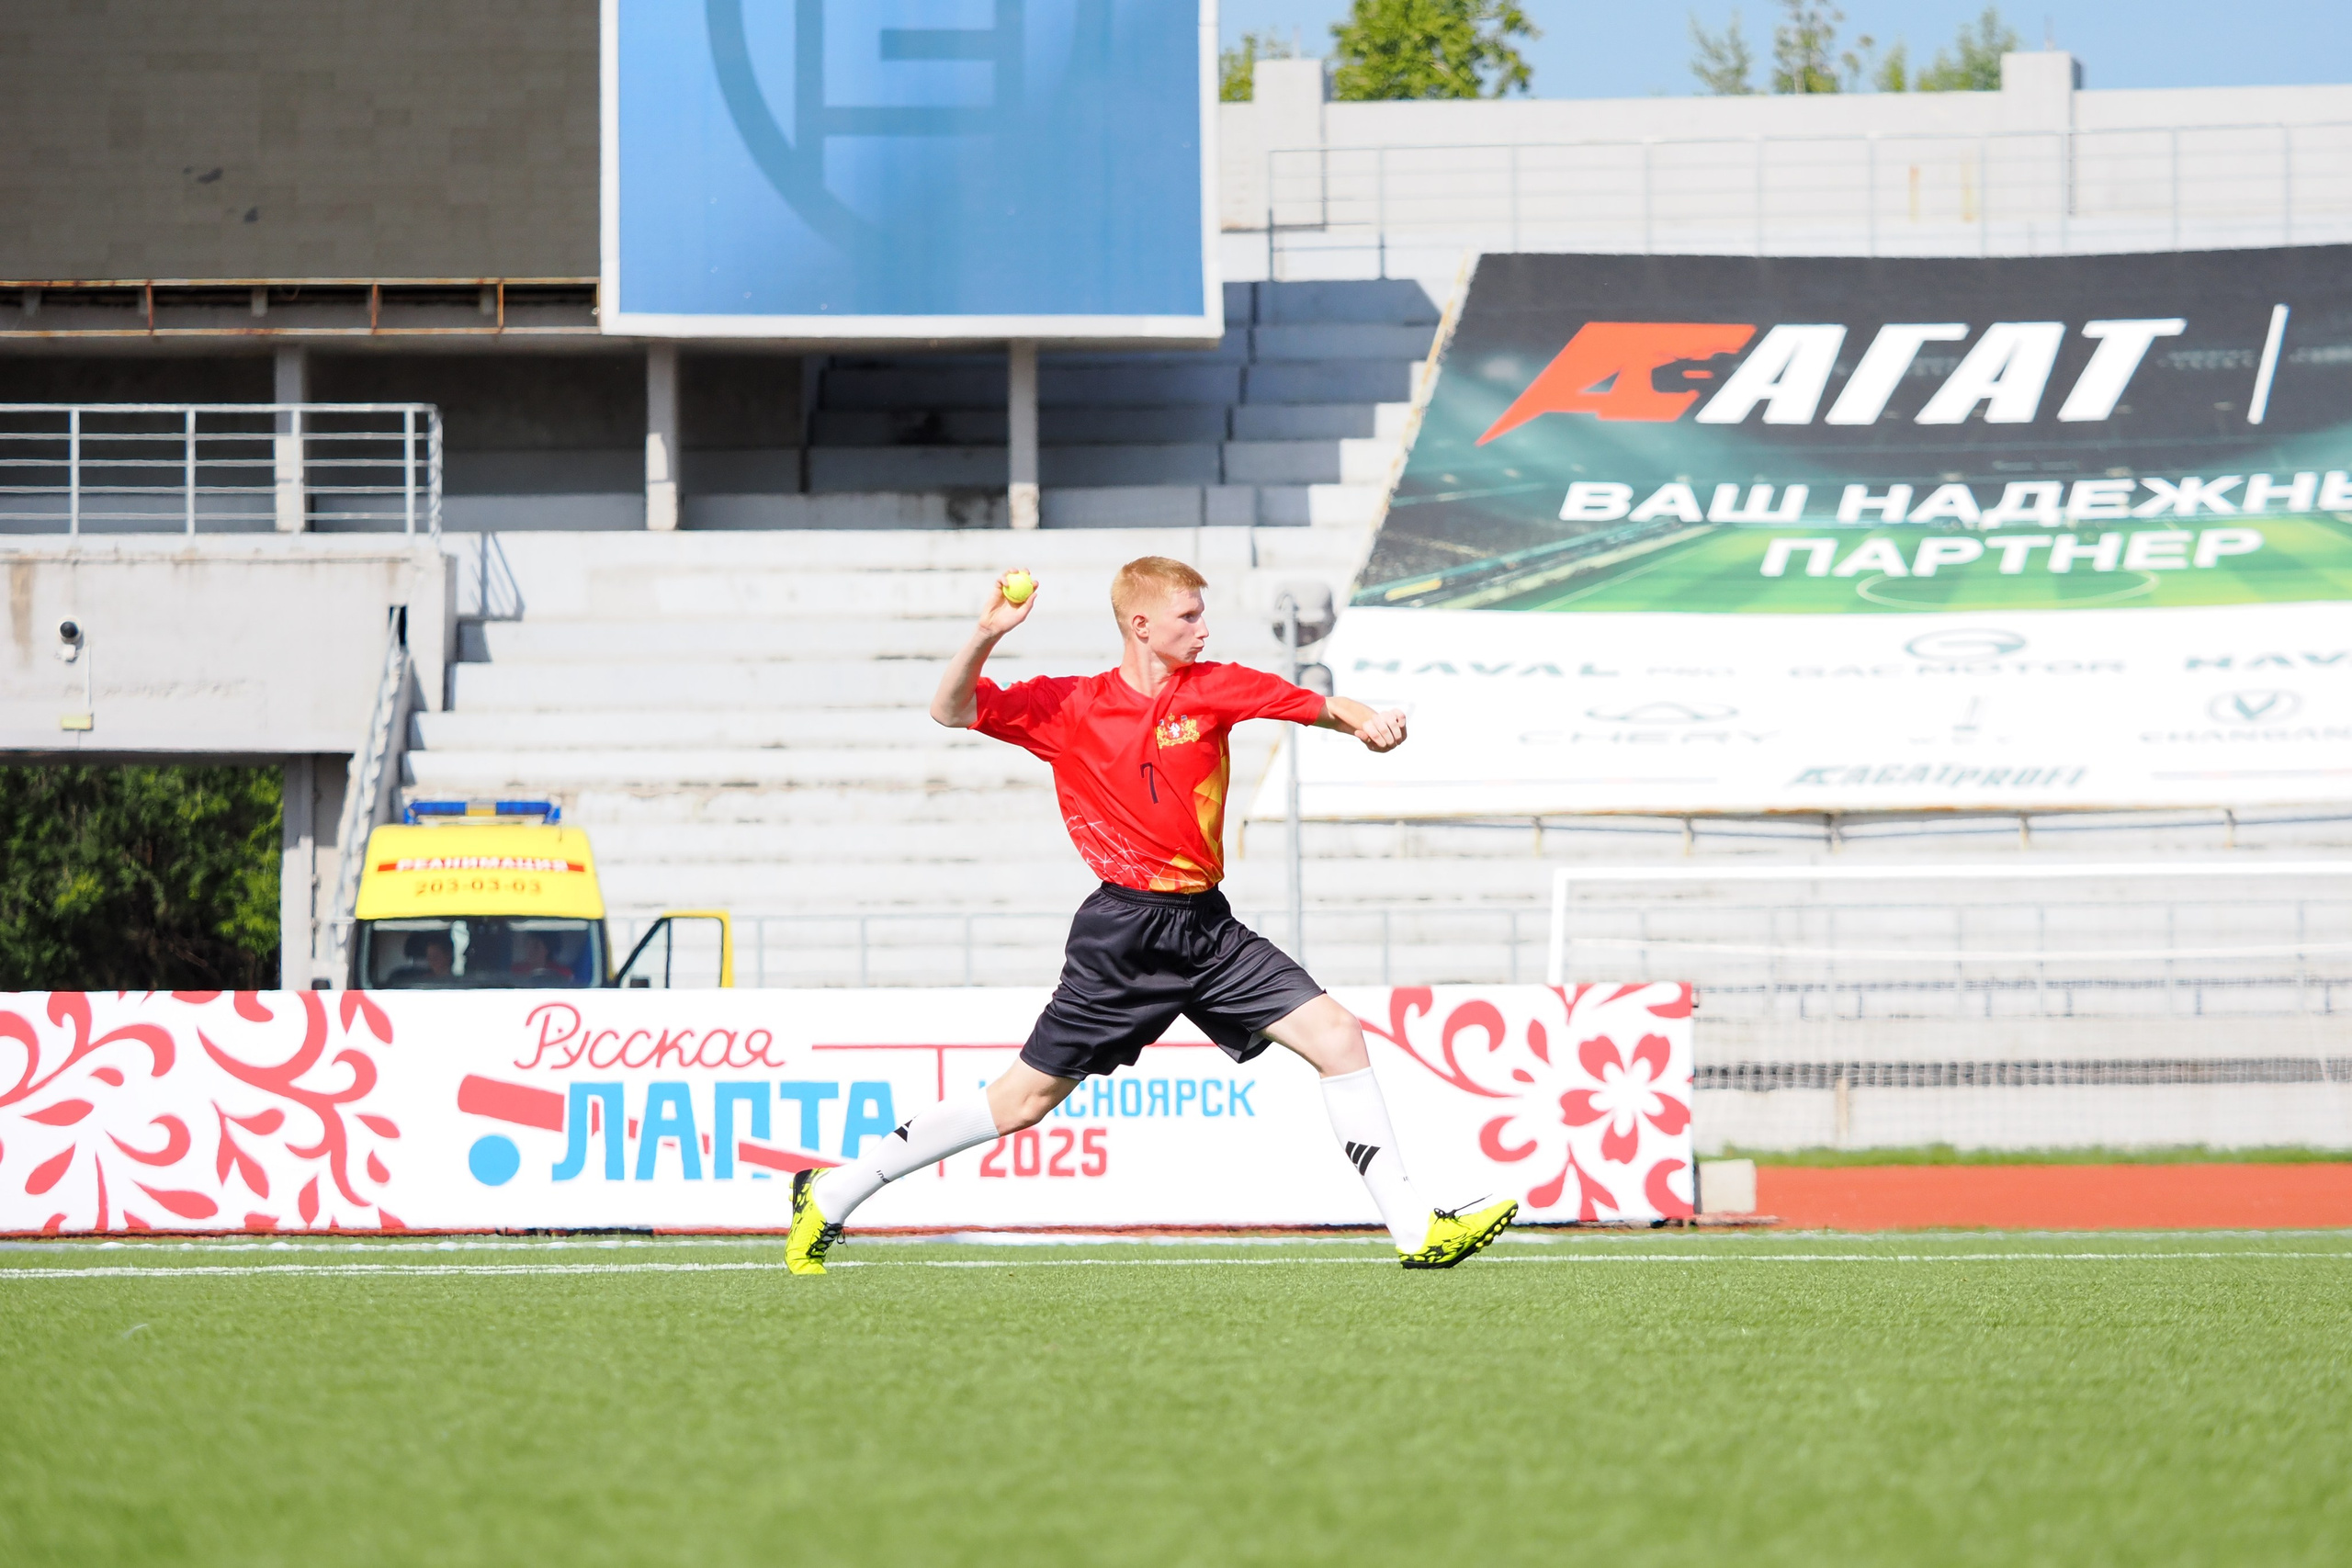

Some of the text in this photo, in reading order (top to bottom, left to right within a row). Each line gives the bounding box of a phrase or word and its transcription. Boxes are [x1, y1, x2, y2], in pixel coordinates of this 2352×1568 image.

[1559, 480, 1810, 524] ВАШ
[1759, 527, 2265, 578] ПАРТНЕР
[1351, 658, 1620, 678] HAVAL
[1787, 659, 2127, 679] GAC MOTOR
[1517, 728, 1782, 746] CHERY
[2137, 725, 2352, 745] CHANGAN
[1139, 761, 1159, 805] 7
[395, 856, 569, 874] РЕАНИМАЦИЯ
[416, 878, 541, 897] 203-03-03
[513, 1001, 786, 1070] Русская
[551, 1080, 898, 1181] ЛАПТА
[979, 1126, 1108, 1178] 2025
